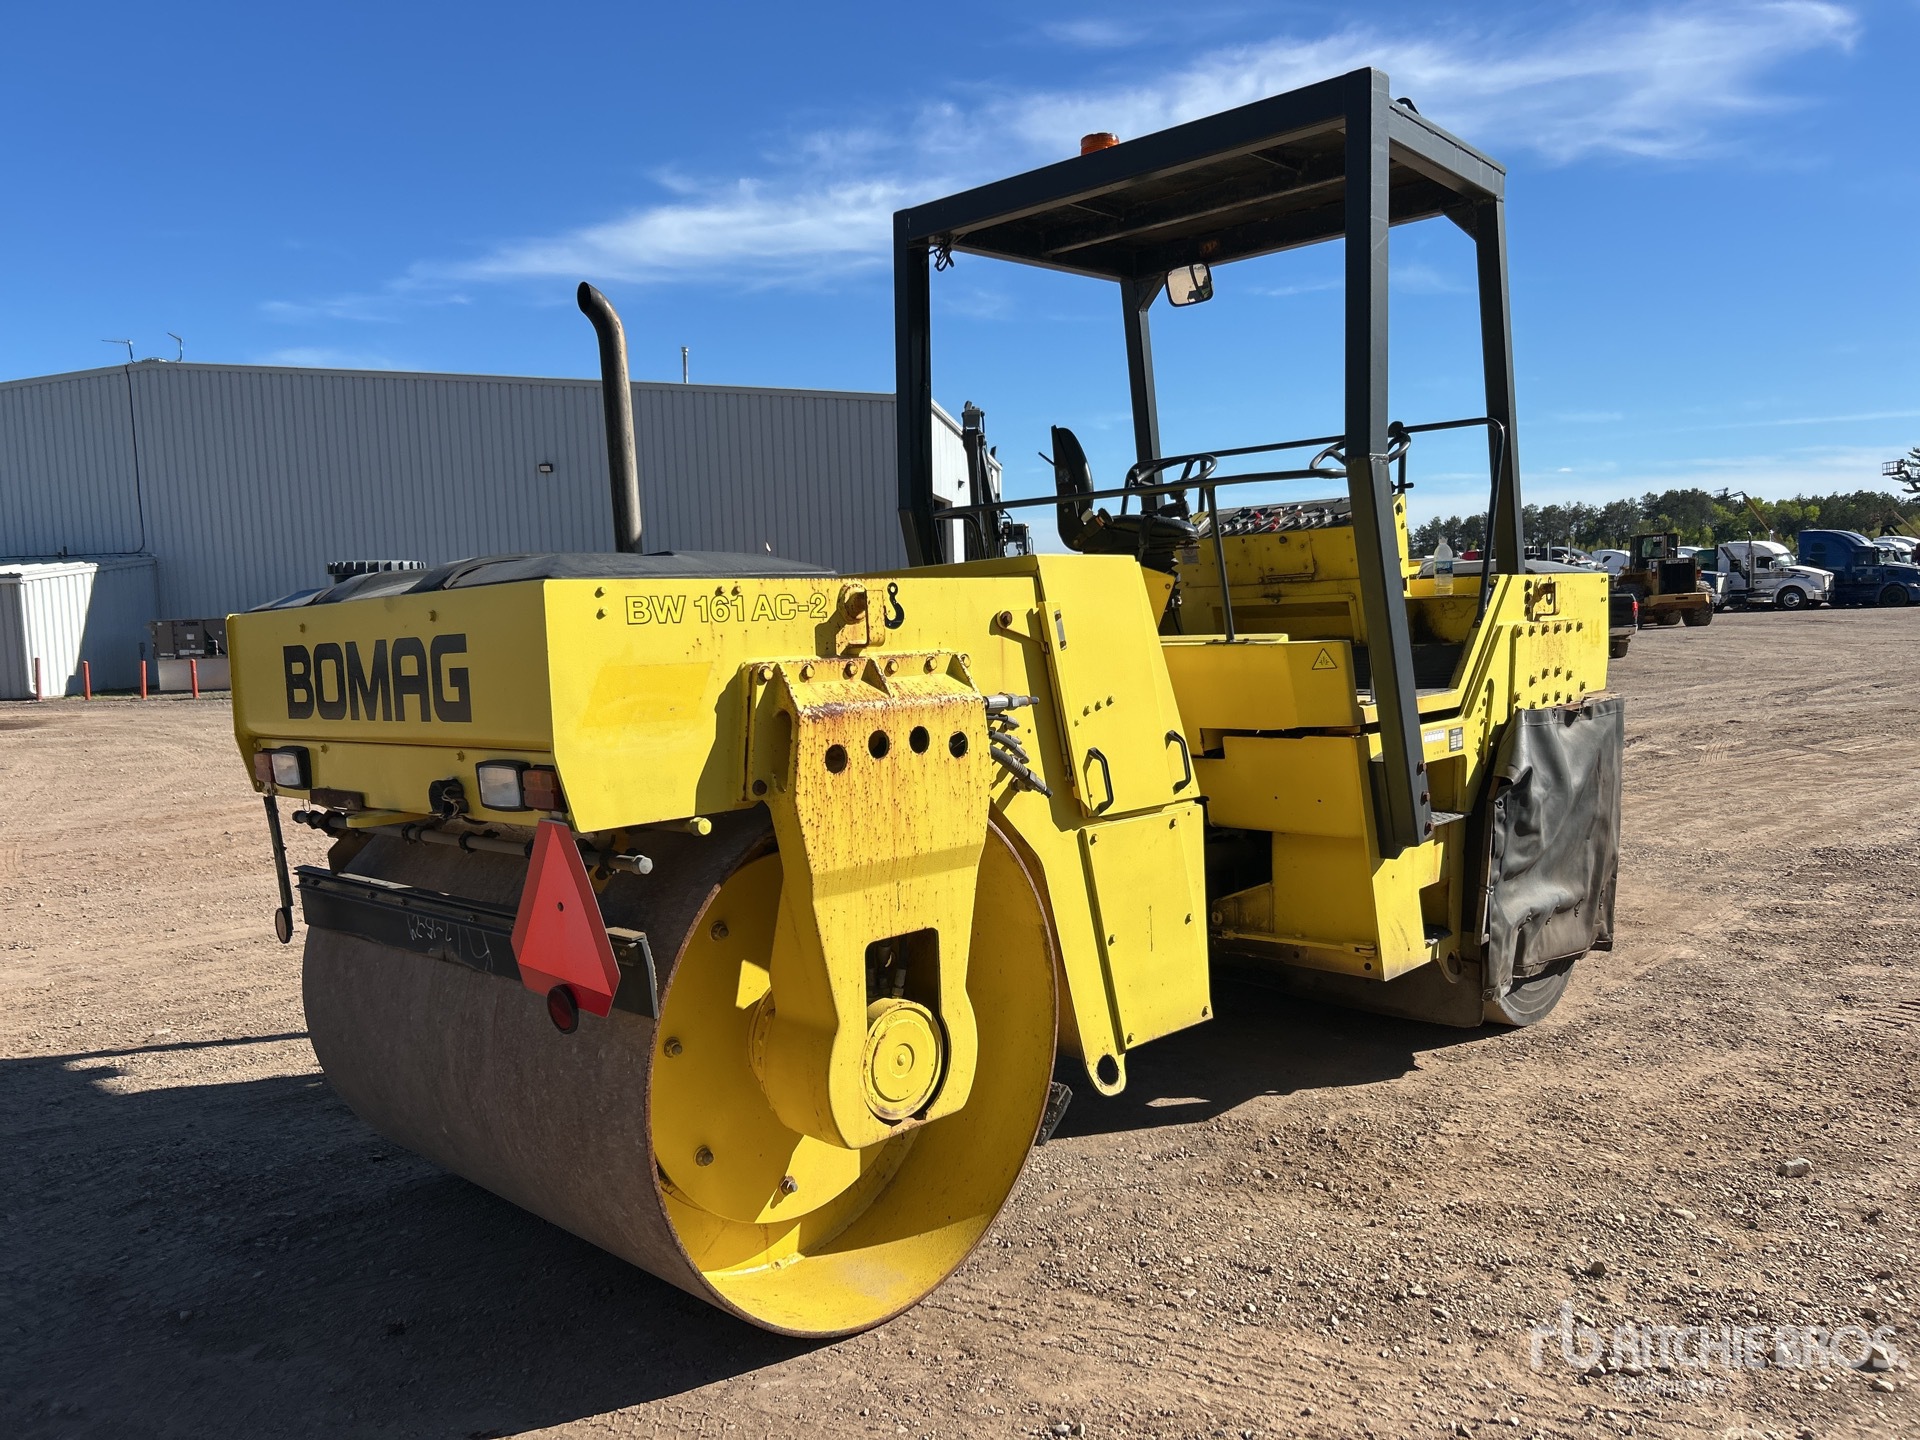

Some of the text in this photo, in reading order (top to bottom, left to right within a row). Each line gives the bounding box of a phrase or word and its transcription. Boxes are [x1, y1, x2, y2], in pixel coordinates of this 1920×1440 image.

[625, 593, 828, 625] BW 161 AC-2
[283, 633, 472, 723] BOMAG
